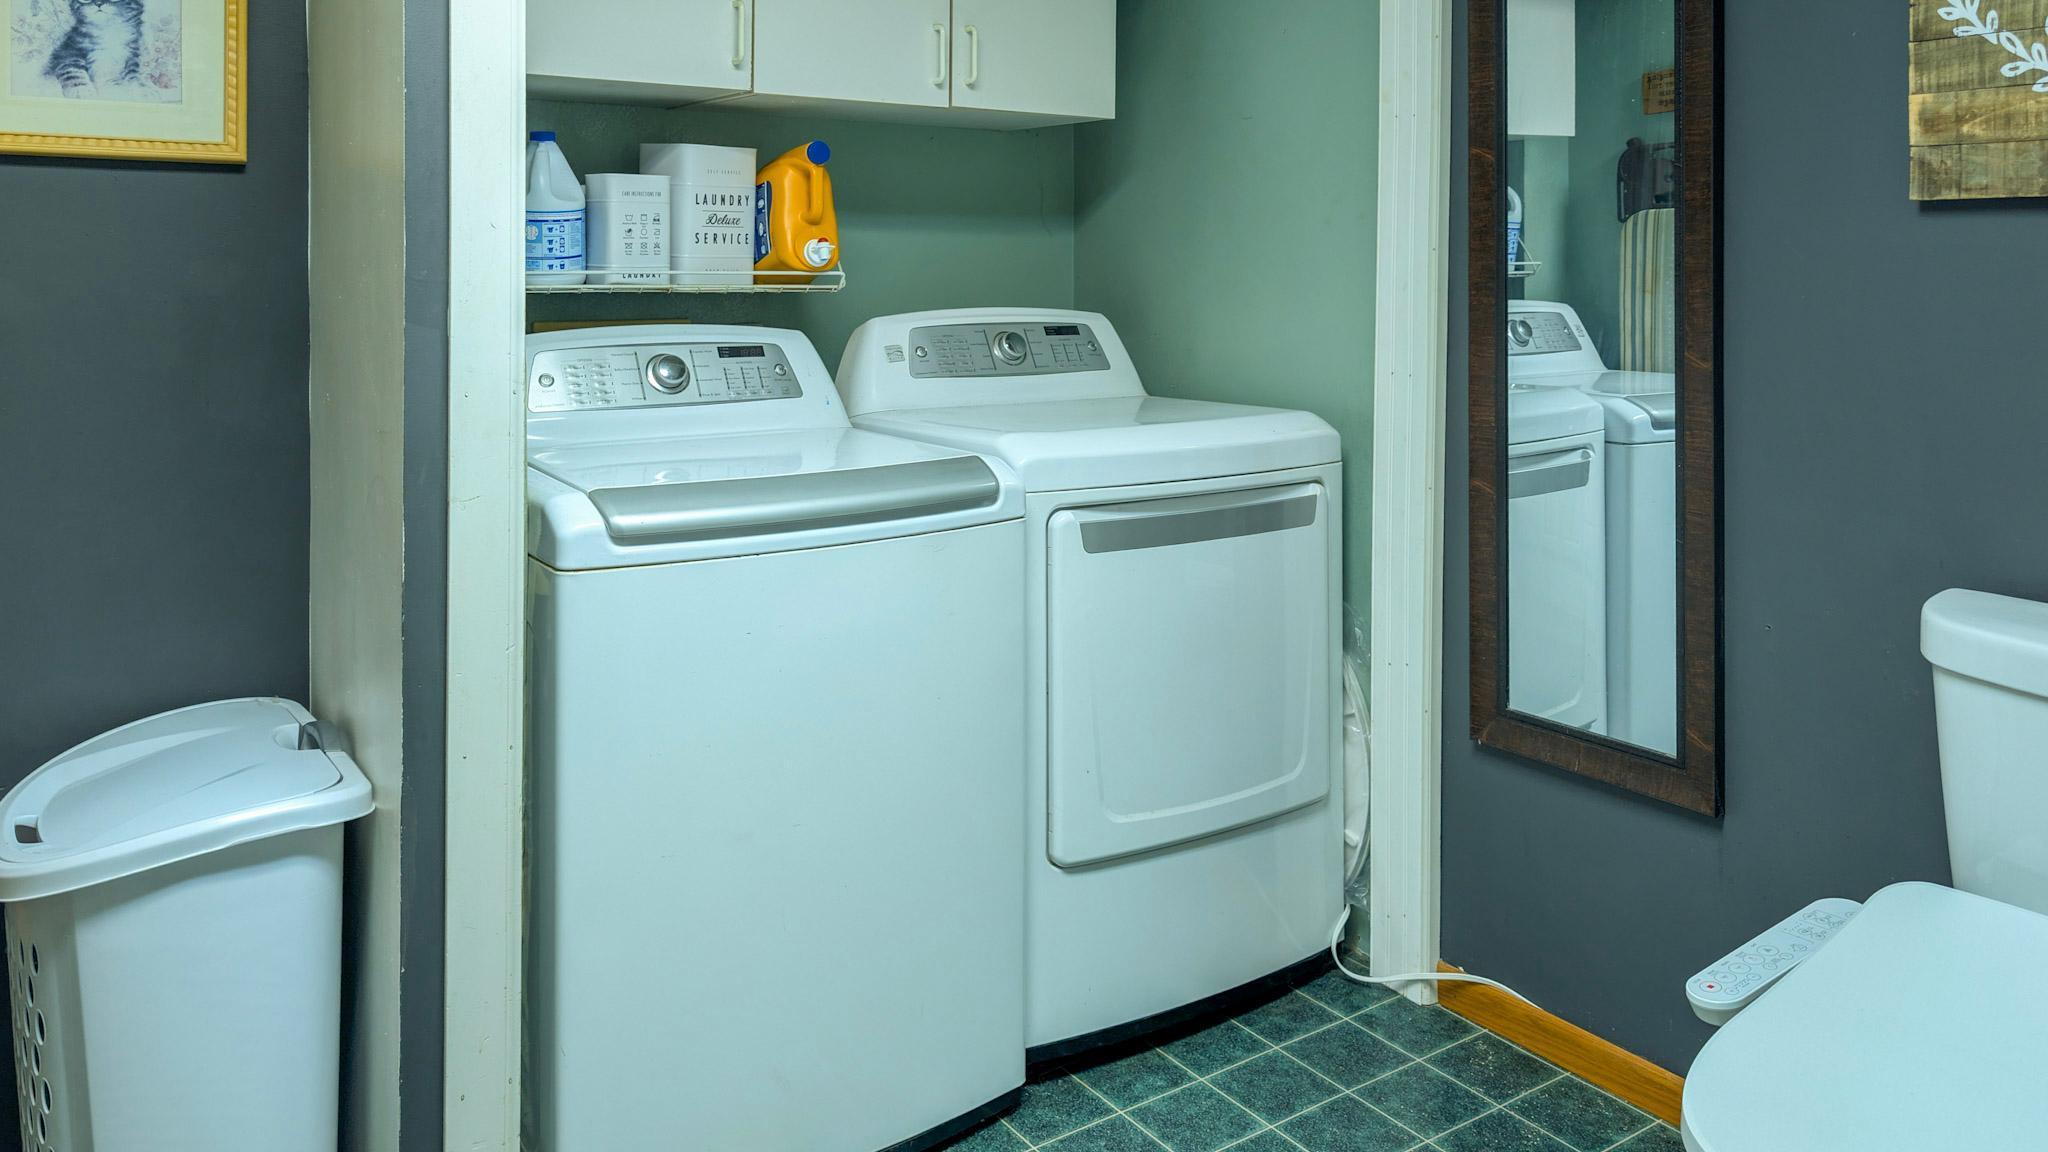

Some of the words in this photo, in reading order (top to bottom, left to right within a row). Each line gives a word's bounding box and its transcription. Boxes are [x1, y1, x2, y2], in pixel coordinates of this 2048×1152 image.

[695, 193, 750, 207] LAUNDRY
[705, 213, 741, 226] Deluxe
[694, 232, 749, 245] SERVICE
